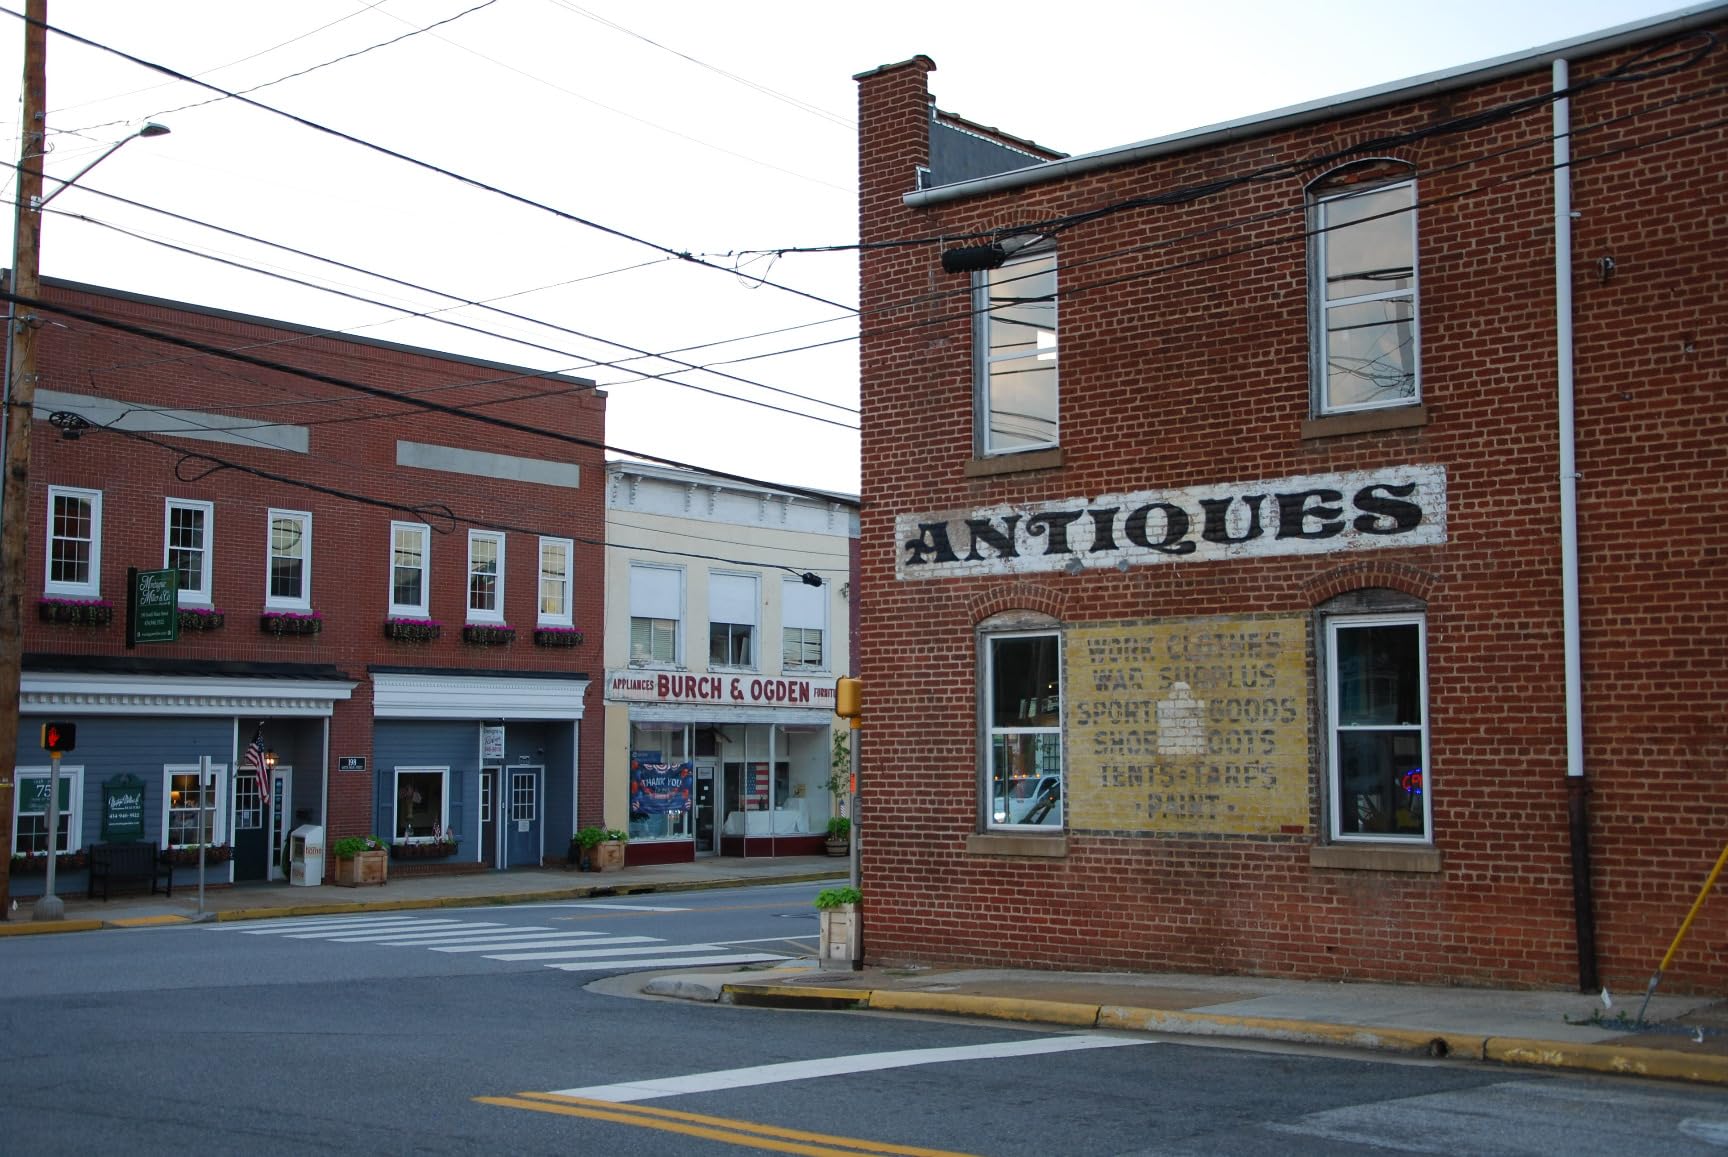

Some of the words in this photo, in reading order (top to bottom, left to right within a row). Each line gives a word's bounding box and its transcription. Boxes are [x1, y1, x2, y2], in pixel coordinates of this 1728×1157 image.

[904, 482, 1422, 565] ANTIQUES
[1087, 636, 1154, 664] WORK
[1167, 632, 1281, 661] CLOTHES
[612, 678, 655, 692] APPLIANCES
[657, 674, 722, 700] BURCH
[729, 678, 744, 701] &
[750, 678, 811, 703] OGDEN
[1092, 667, 1144, 692] WAR
[1159, 663, 1276, 689] SURPLUS
[1209, 696, 1297, 724] GOODS
[641, 777, 666, 787] THANK
[667, 777, 682, 787] YOU
